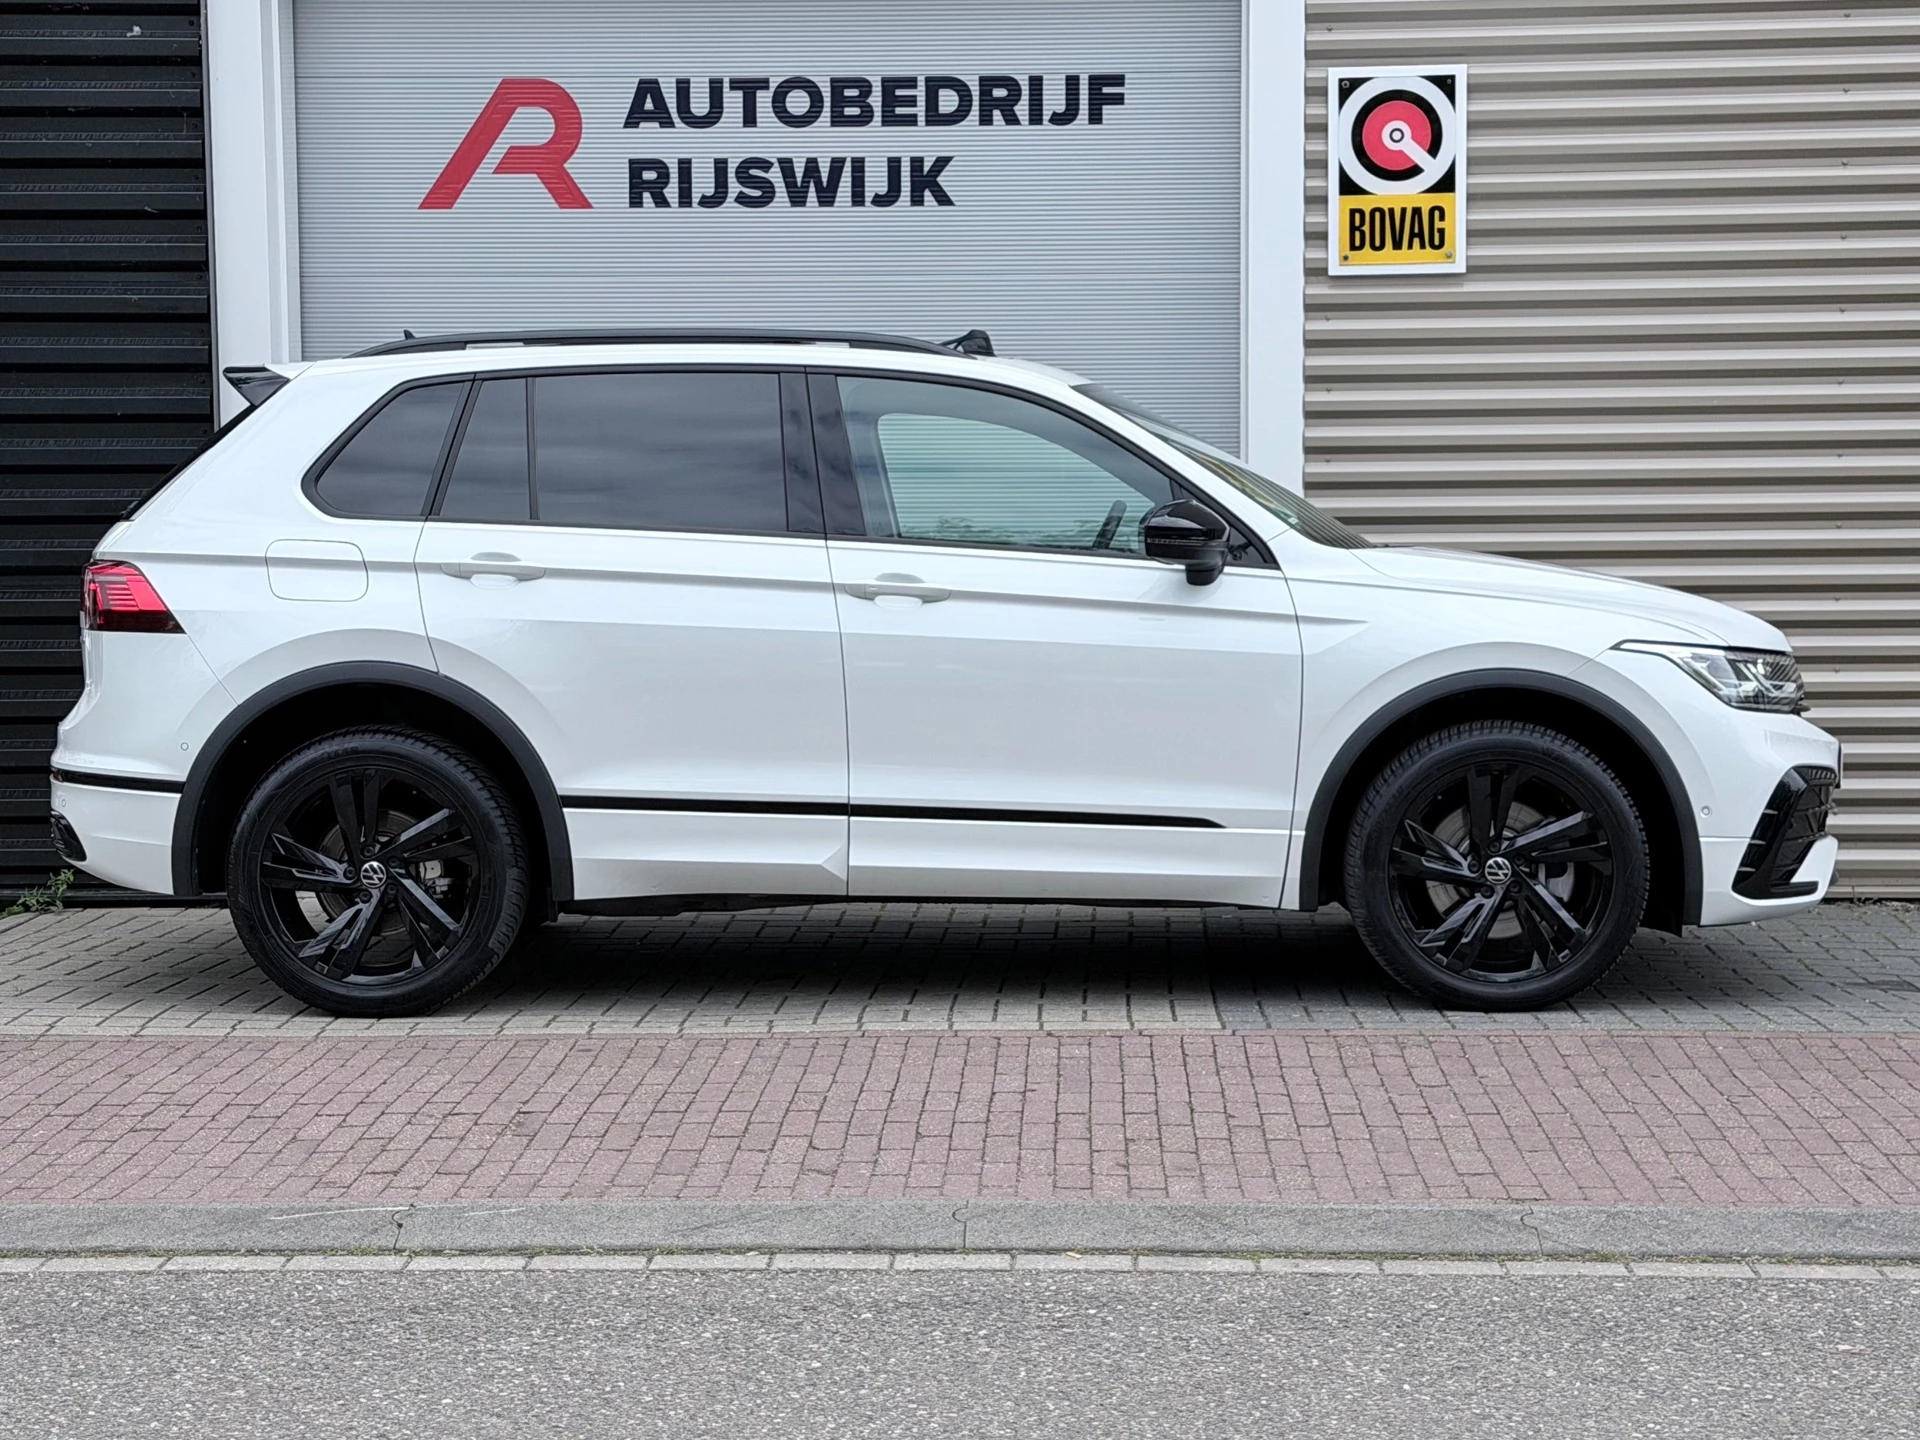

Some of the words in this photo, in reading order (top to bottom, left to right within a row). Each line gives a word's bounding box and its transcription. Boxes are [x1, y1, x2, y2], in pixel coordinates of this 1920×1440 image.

[622, 74, 1126, 129] AUTOBEDRIJF
[628, 155, 956, 209] RIJSWIJK
[1348, 205, 1446, 252] BOVAG
